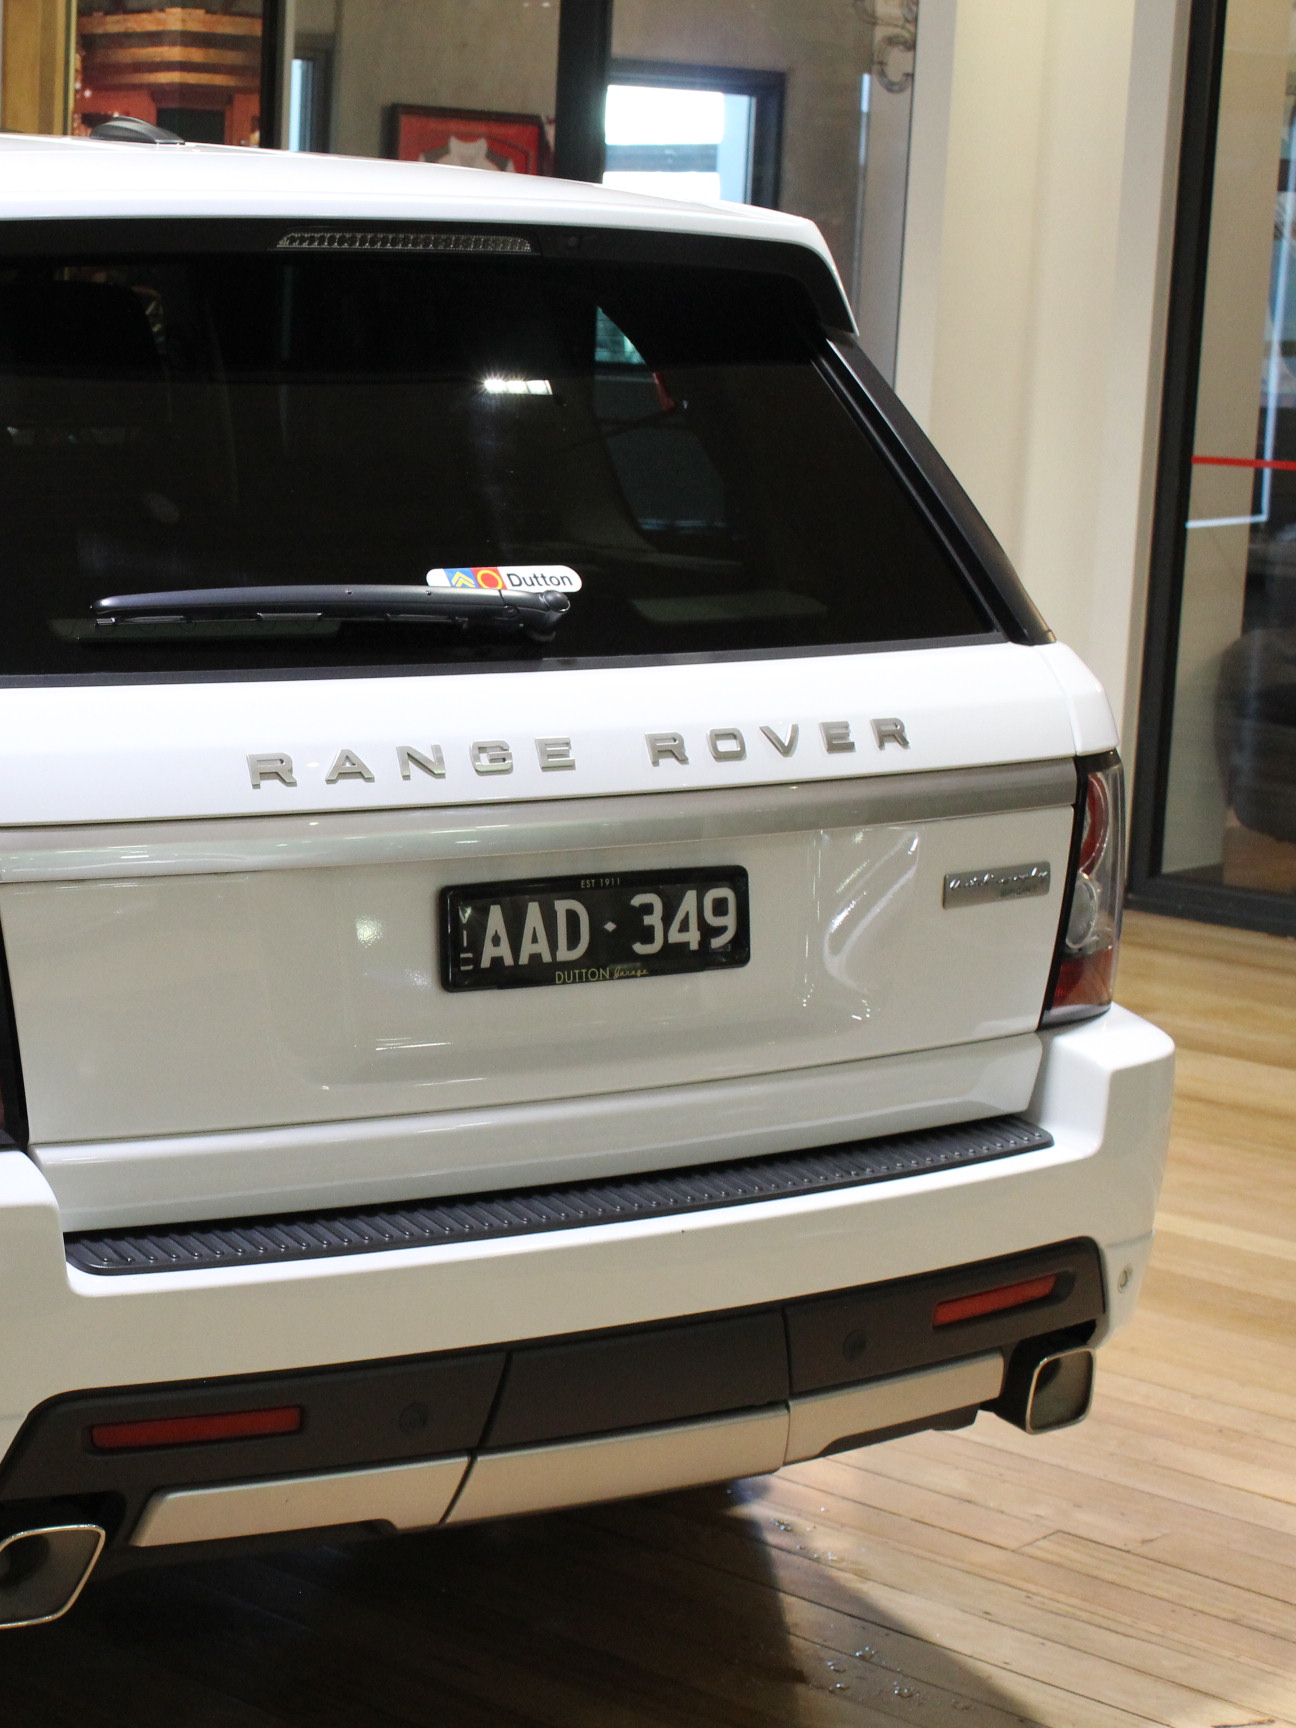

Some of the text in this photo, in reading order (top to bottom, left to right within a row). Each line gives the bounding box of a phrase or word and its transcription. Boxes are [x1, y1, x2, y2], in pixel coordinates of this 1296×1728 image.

[506, 573, 573, 587] Dutton
[246, 717, 910, 789] RANGE ROVER
[580, 877, 620, 889] EST 1911
[630, 887, 738, 955] 349
[555, 967, 610, 984] DUTTON
